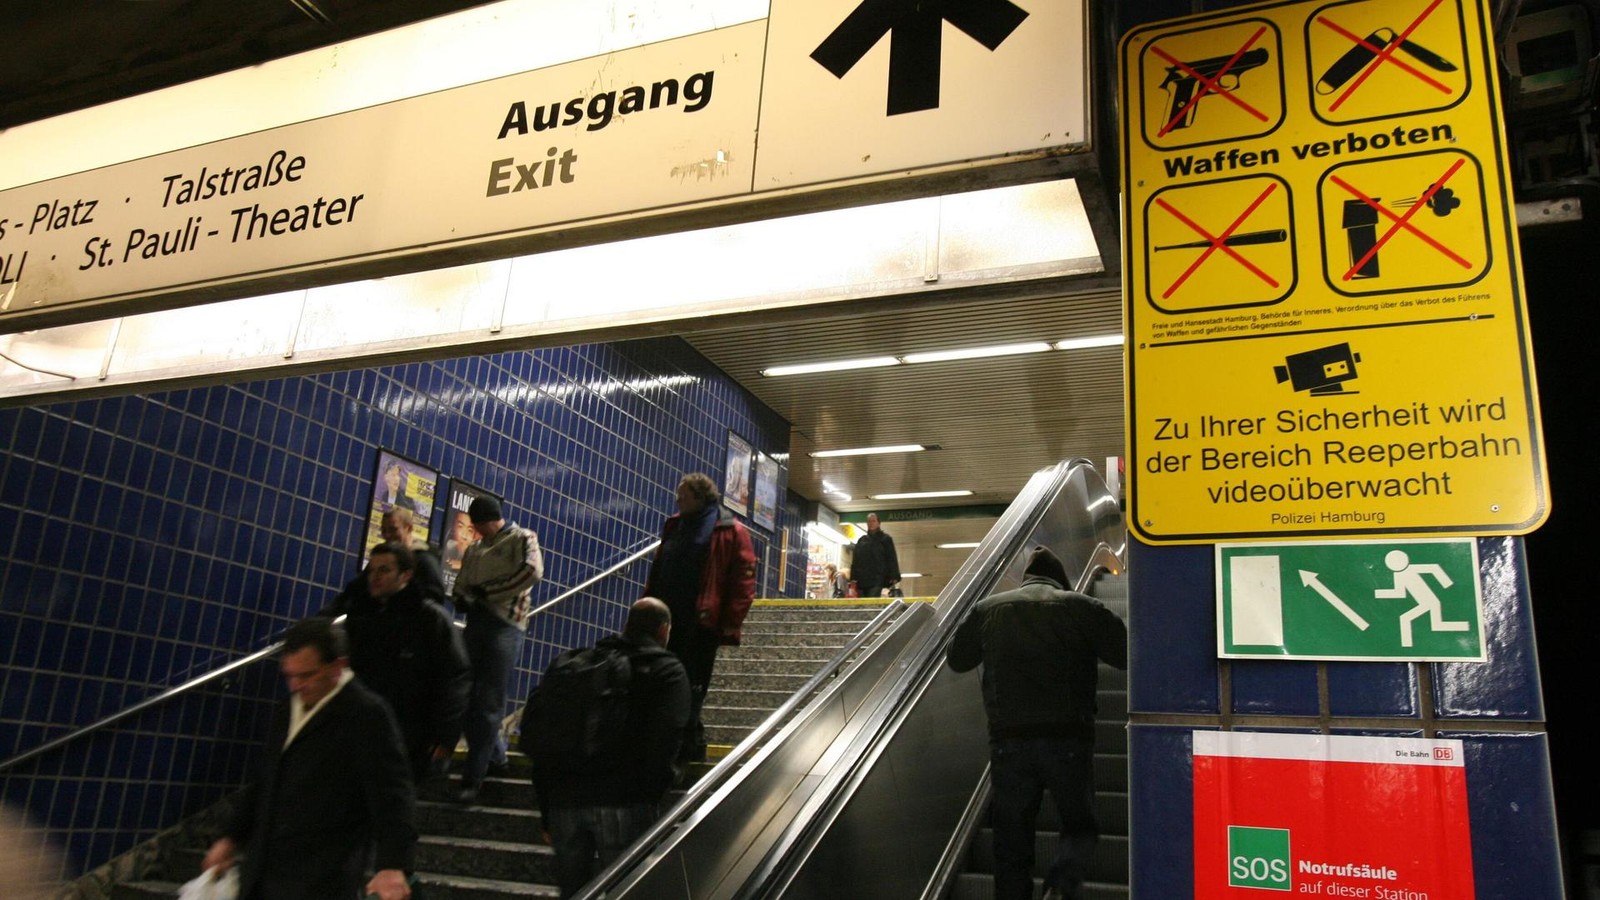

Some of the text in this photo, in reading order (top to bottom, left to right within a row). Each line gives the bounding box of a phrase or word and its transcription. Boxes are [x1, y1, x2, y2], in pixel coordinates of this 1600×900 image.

[497, 70, 715, 140] Ausgang
[1163, 123, 1453, 178] Waffen verboten
[162, 150, 306, 208] Talstraße
[486, 146, 578, 198] Exit
[0, 251, 28, 285] LI
[79, 236, 113, 271] St.
[1152, 322, 1169, 330] Freie
[1184, 318, 1224, 327] Hansestadt
[1260, 311, 1291, 320] Behörde
[1292, 309, 1303, 317] für
[1335, 304, 1379, 314] Verordnung
[1380, 301, 1398, 309] über
[1399, 299, 1413, 307] das
[1415, 297, 1440, 306] Verbot
[1441, 296, 1456, 304] des
[1458, 293, 1491, 302] Führens
[1166, 329, 1189, 337] Waffen
[1205, 324, 1249, 335] gefährlichen
[1250, 319, 1302, 331] Gegenständen
[1154, 397, 1506, 441] Zu Ihrer Sicherheit wird
[1146, 433, 1521, 474] der Bereich Reeperbahn
[1208, 472, 1452, 504] videoüberwacht
[1271, 510, 1386, 525] Polizei Hamburg
[1435, 748, 1452, 759] DB
[1232, 855, 1287, 883] SOS
[1299, 860, 1398, 880] Notrufsäule
[1299, 880, 1428, 900] auf dieser Station
